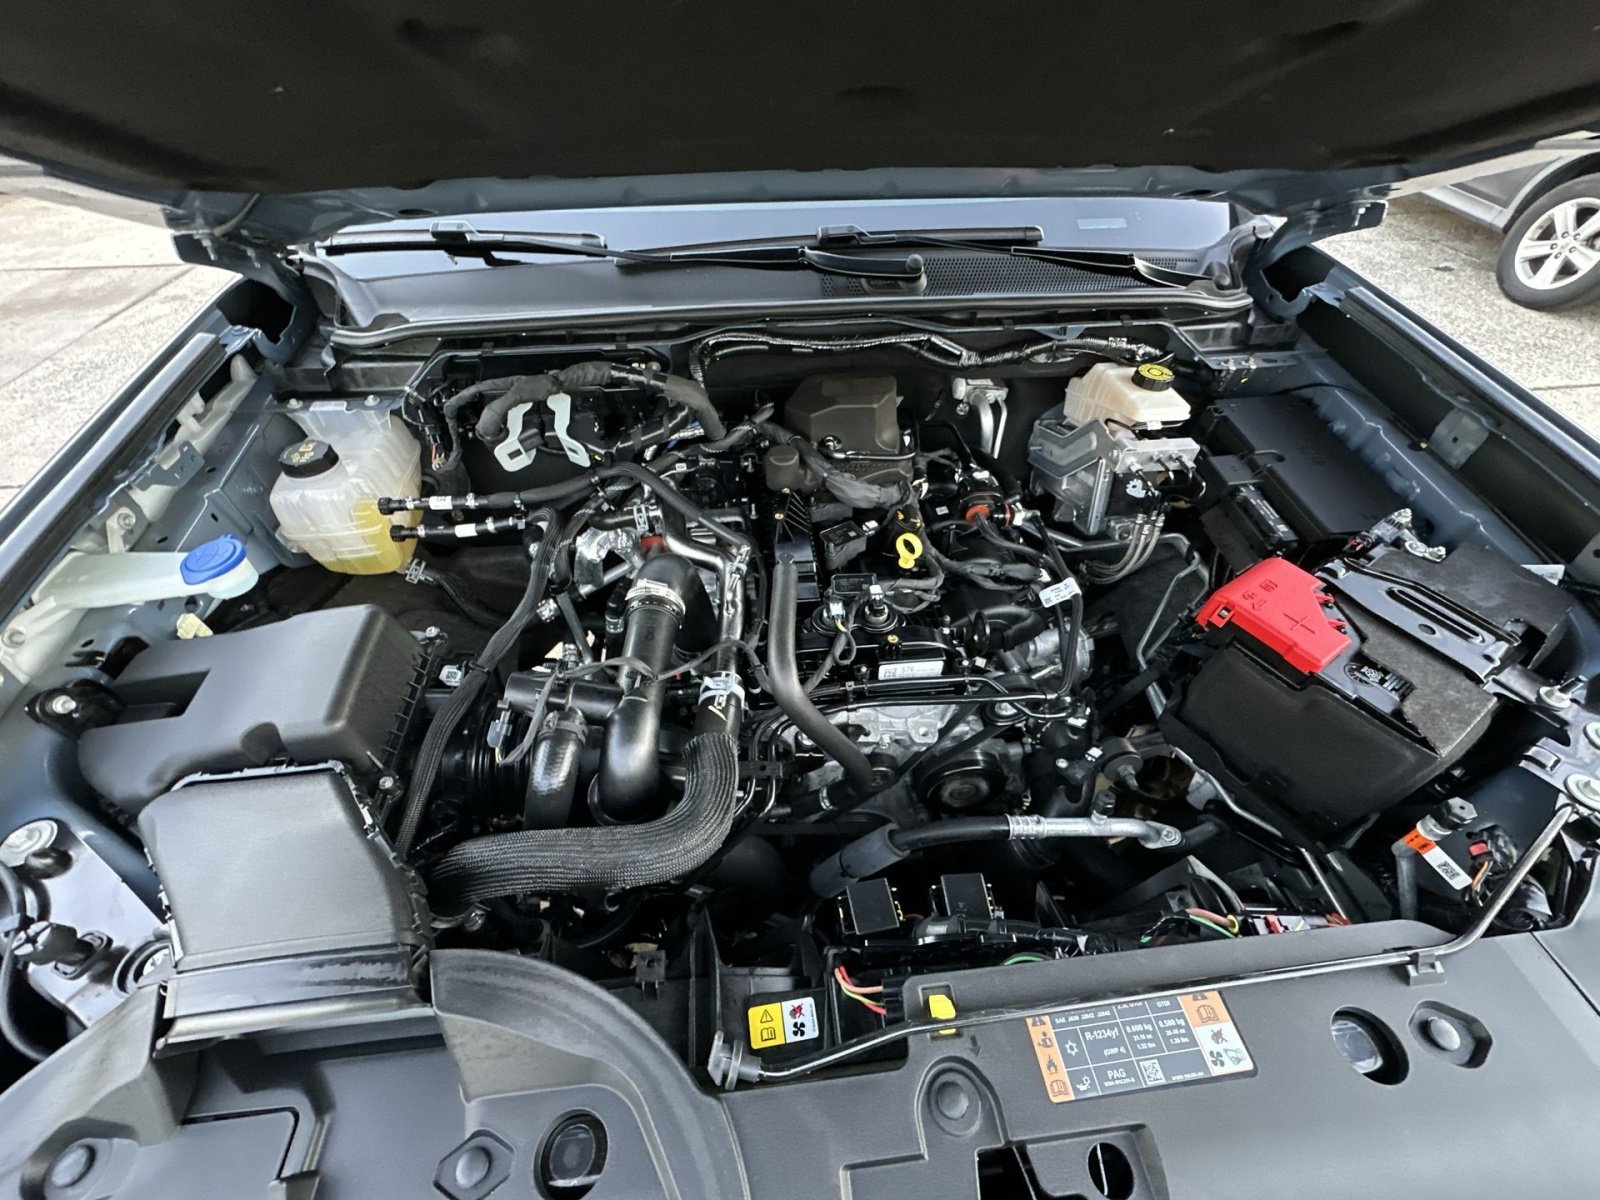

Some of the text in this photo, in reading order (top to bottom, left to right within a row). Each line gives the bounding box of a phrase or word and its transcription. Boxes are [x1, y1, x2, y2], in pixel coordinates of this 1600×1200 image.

[1143, 1022, 1153, 1031] kg
[1176, 1018, 1186, 1026] kg
[1084, 1027, 1120, 1041] R-1234yf
[1107, 1068, 1127, 1080] PAG
